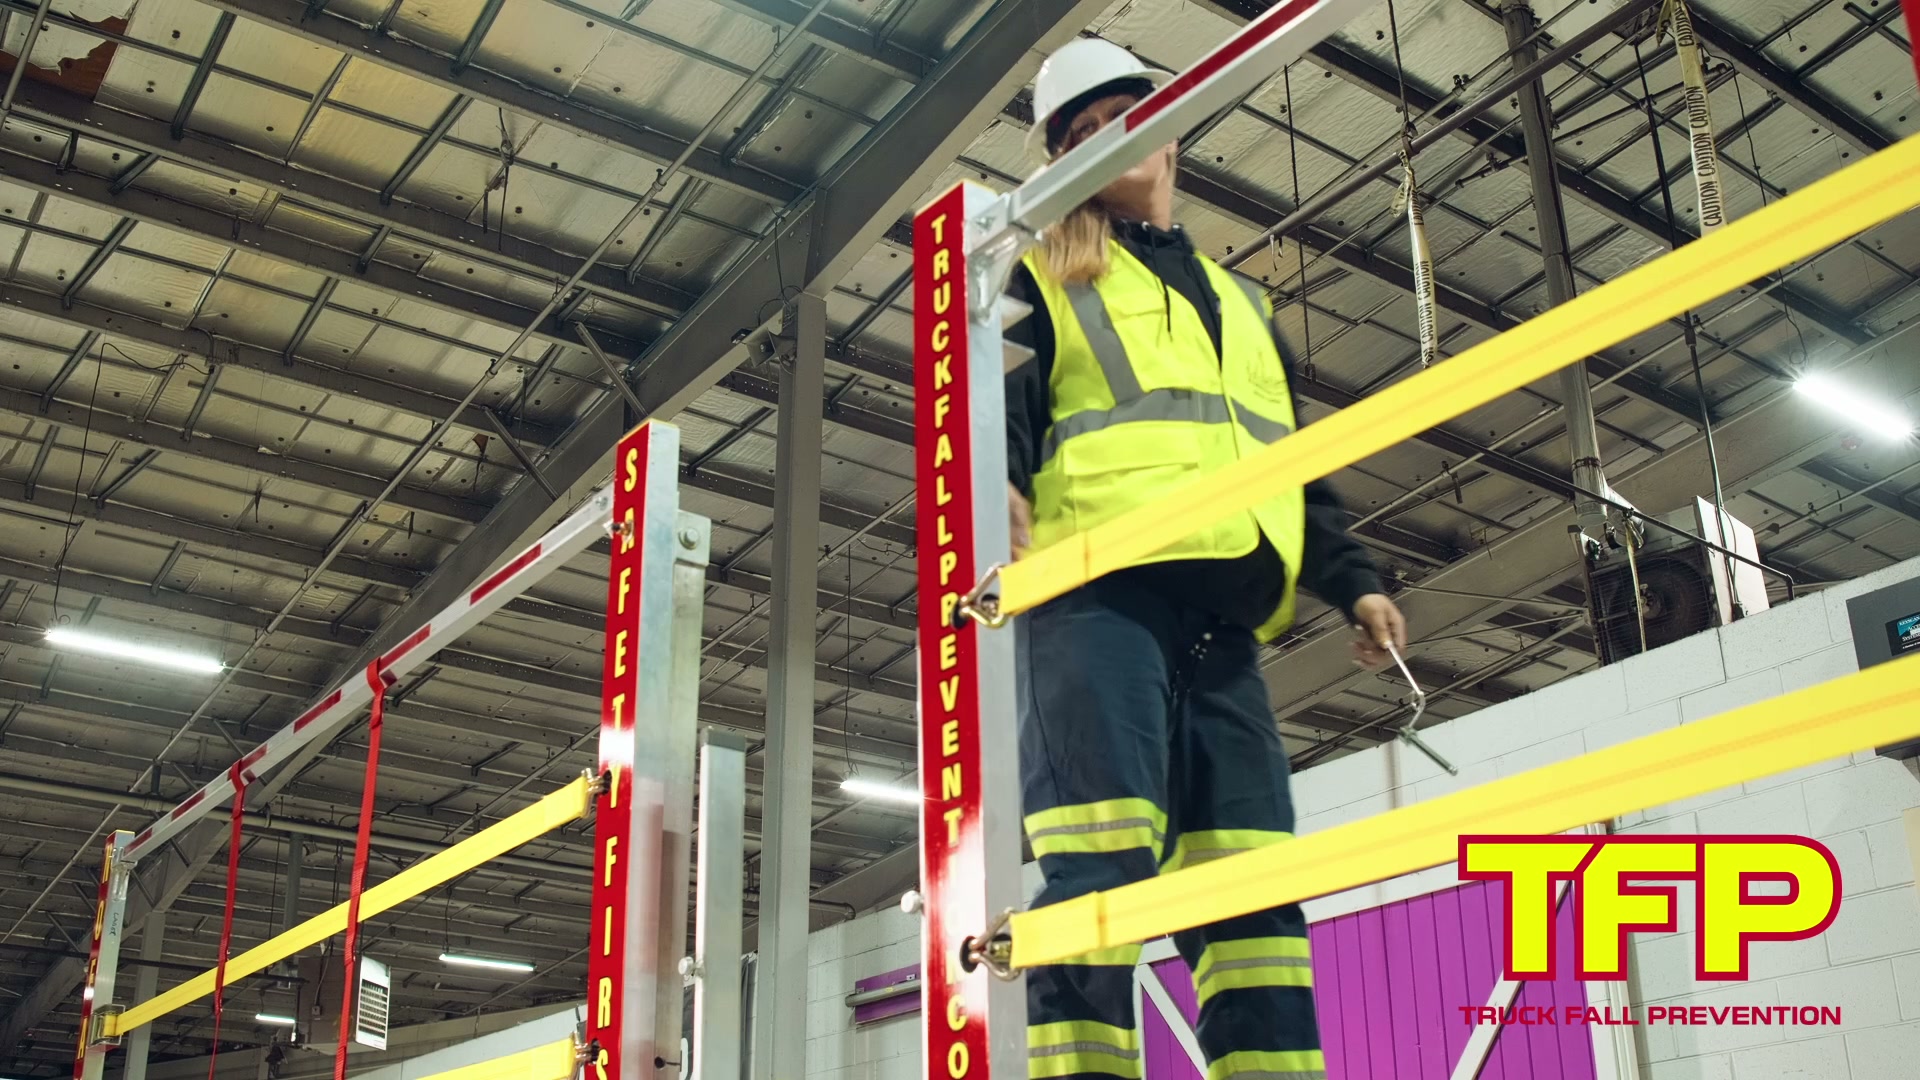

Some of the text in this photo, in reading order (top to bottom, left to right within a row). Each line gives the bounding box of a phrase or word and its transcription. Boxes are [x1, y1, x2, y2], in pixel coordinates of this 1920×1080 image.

[1675, 7, 1723, 227] CAUTION CAUTION CAUTION CAUTION
[1415, 260, 1431, 300] CAUTION
[1418, 303, 1435, 344] CAUTION
[610, 447, 638, 809] SAFETY
